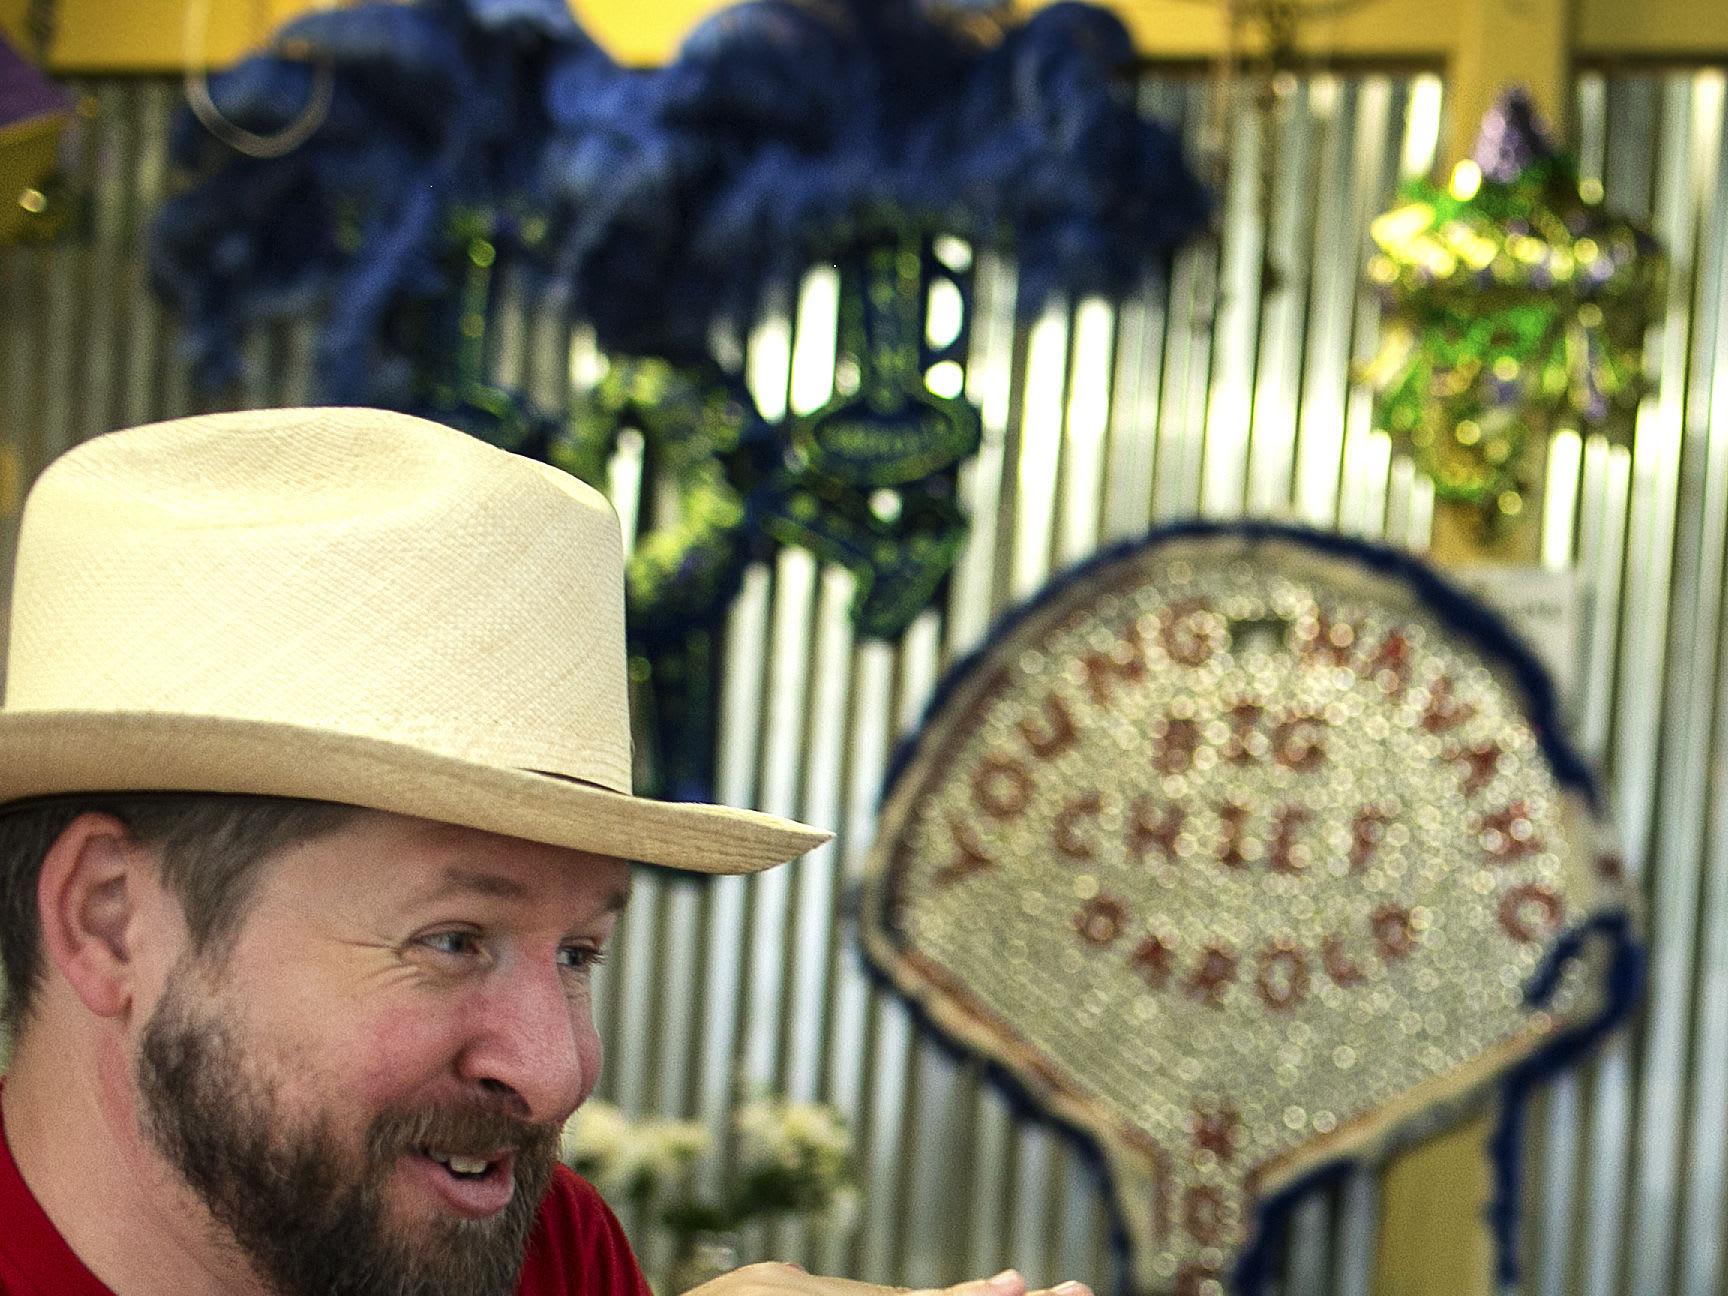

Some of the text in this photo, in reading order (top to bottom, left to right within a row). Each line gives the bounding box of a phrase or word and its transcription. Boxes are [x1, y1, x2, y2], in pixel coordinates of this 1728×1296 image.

[931, 598, 1217, 887] YOUNG
[1153, 698, 1326, 774] BIG
[1050, 793, 1392, 872] CHIEF
